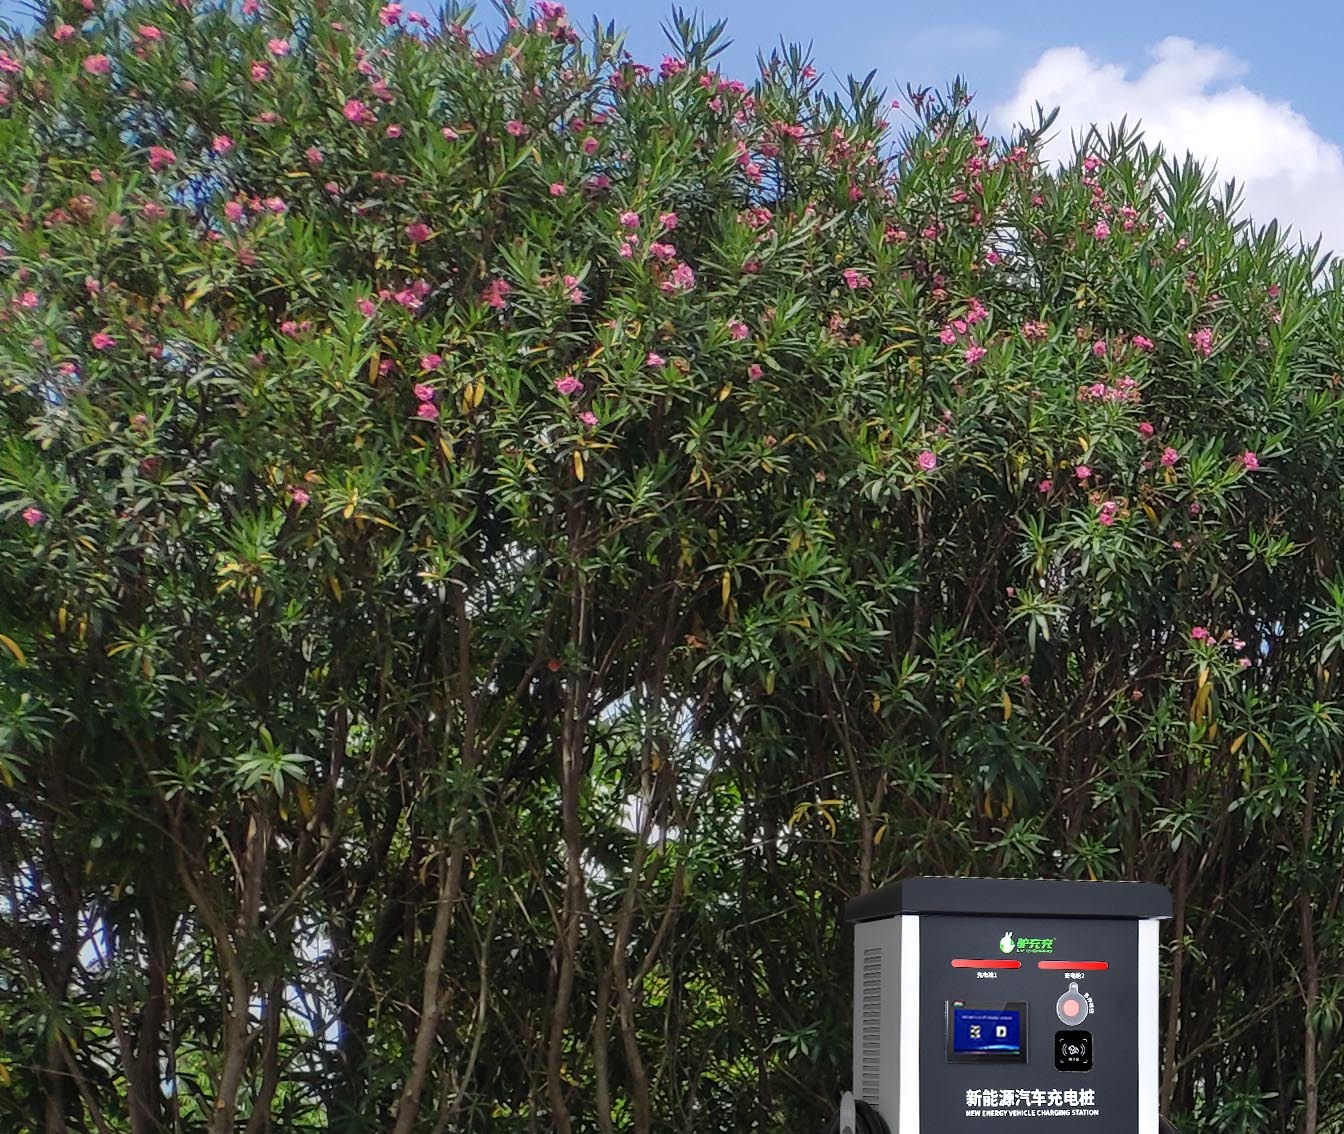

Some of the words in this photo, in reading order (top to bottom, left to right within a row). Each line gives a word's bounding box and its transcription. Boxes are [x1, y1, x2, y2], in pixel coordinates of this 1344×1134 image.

[965, 1087, 1096, 1108] 新能源汽车充电桩
[965, 1109, 981, 1117] NEW
[982, 1109, 1008, 1117] ENERGY
[1008, 1109, 1036, 1117] VEHICLE
[1036, 1109, 1071, 1117] CHARGING
